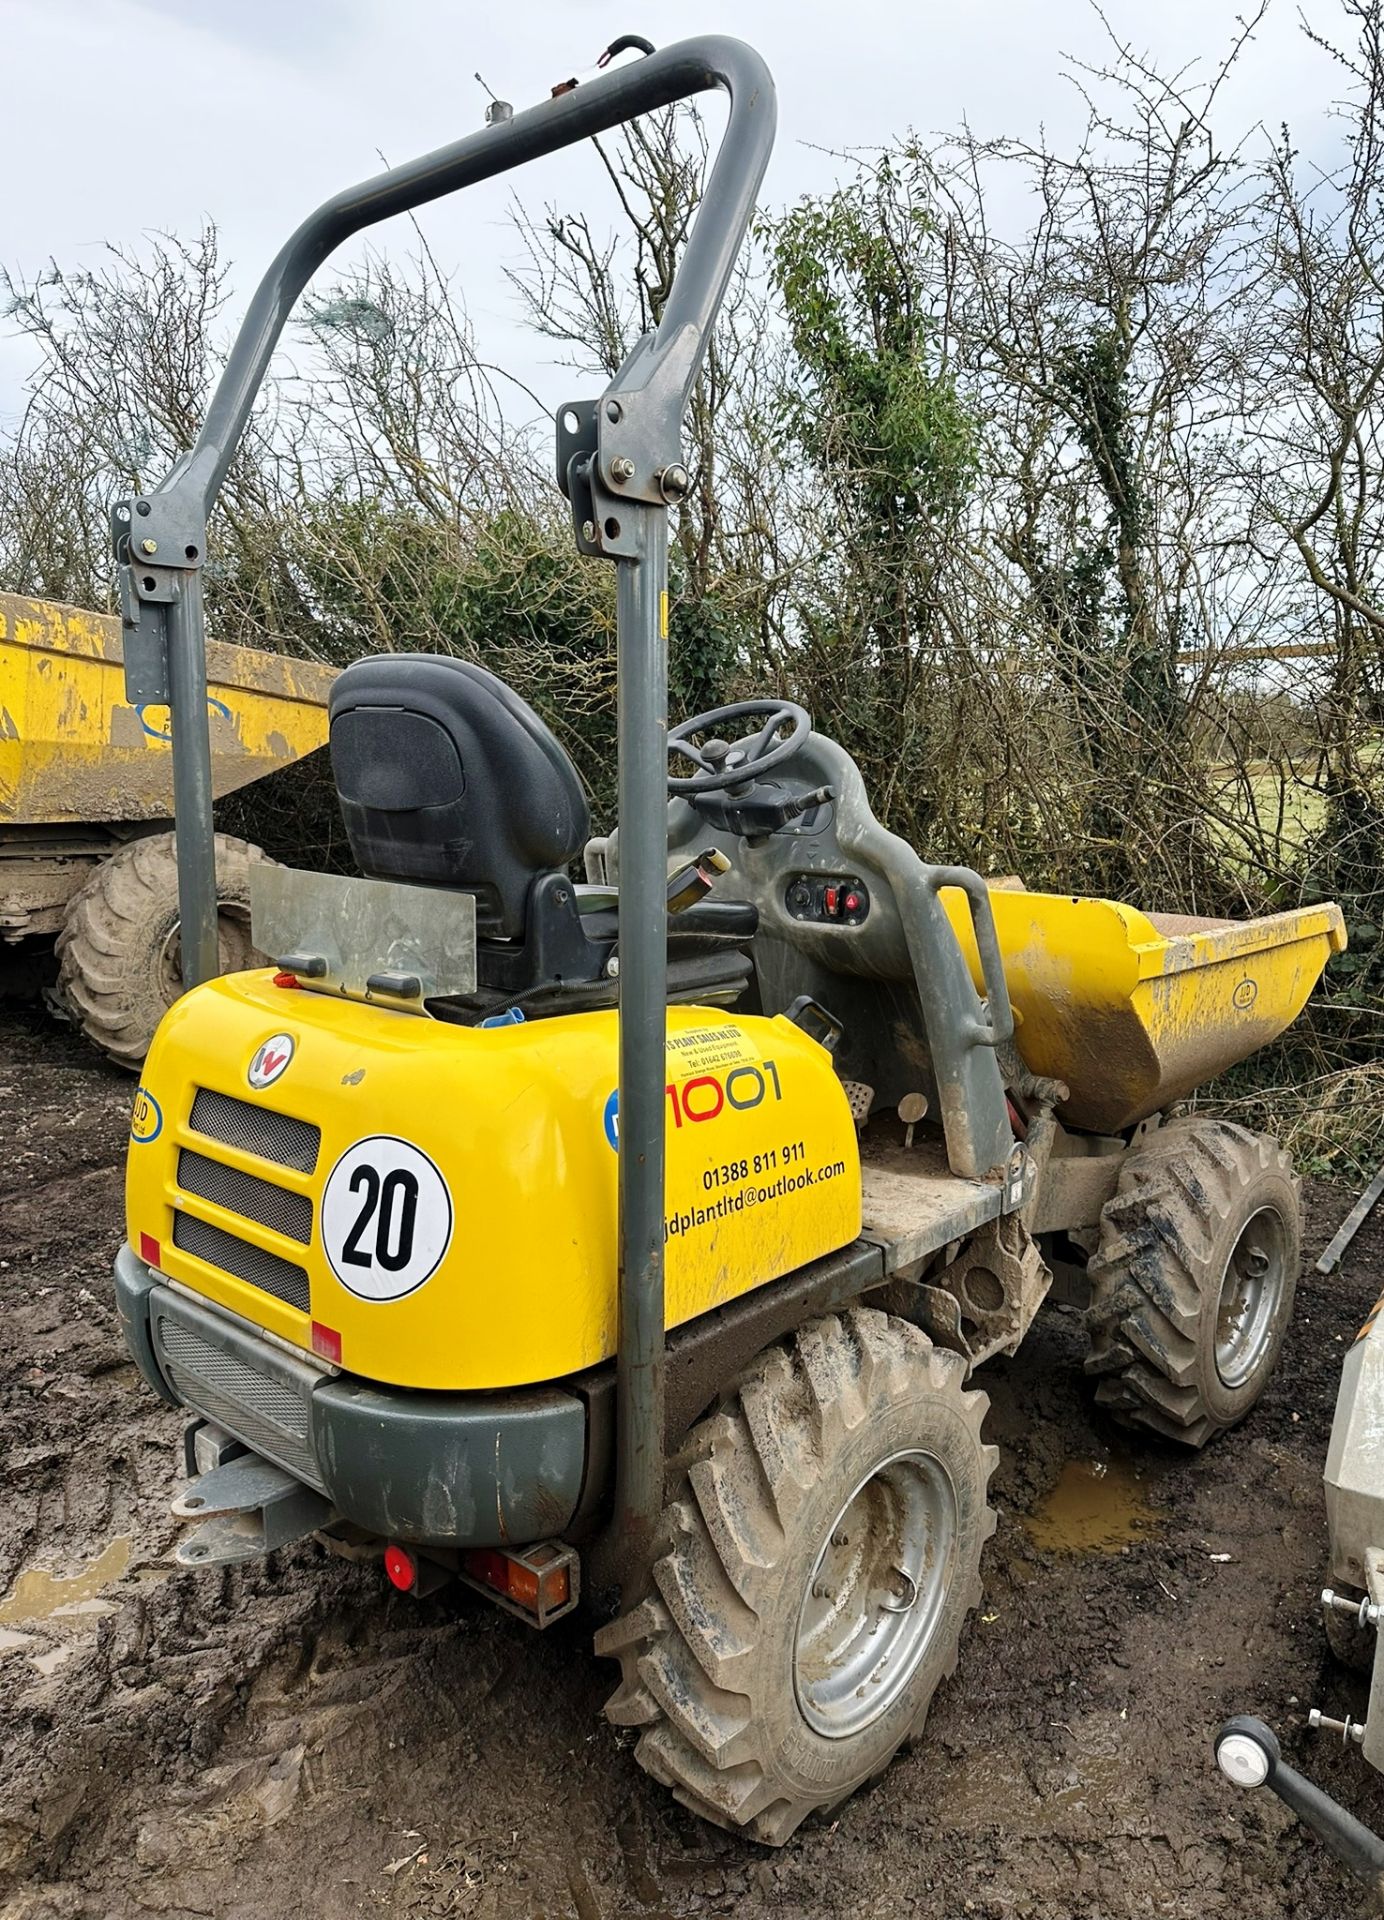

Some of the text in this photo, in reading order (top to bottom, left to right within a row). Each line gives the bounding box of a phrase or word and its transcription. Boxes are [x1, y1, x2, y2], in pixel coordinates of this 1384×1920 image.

[674, 1035, 699, 1049] PLANT
[697, 1031, 720, 1044] SALES
[727, 1028, 742, 1039] LTD
[665, 1060, 783, 1128] 1001
[703, 1141, 806, 1191] 01388 811 911
[341, 1164, 419, 1272] 20
